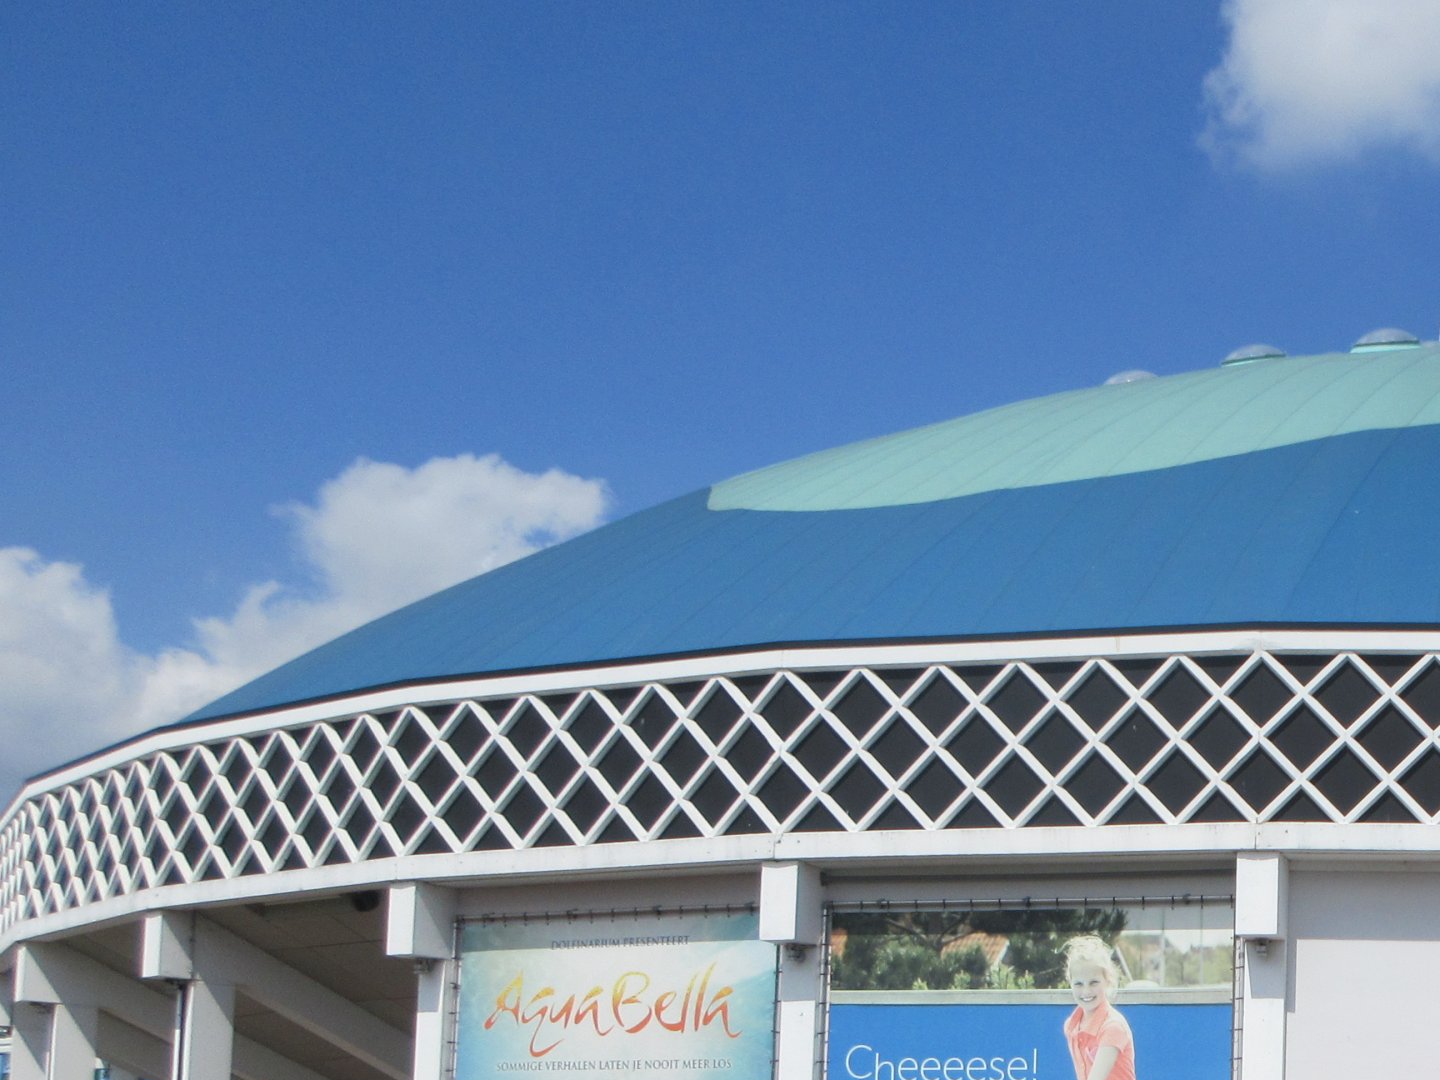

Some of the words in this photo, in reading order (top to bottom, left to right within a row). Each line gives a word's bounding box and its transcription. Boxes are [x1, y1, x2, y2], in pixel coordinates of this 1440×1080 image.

[551, 937, 621, 951] DOLFINARIUM
[623, 935, 690, 948] PRESENTEERT
[496, 1060, 544, 1072] SOMMIGE
[546, 1060, 597, 1072] VERHALEN
[599, 1060, 630, 1071] LATEN
[632, 1060, 643, 1072] JE
[644, 1059, 680, 1070] NOOIT
[682, 1059, 711, 1070] MEER
[712, 1059, 732, 1069] LOS
